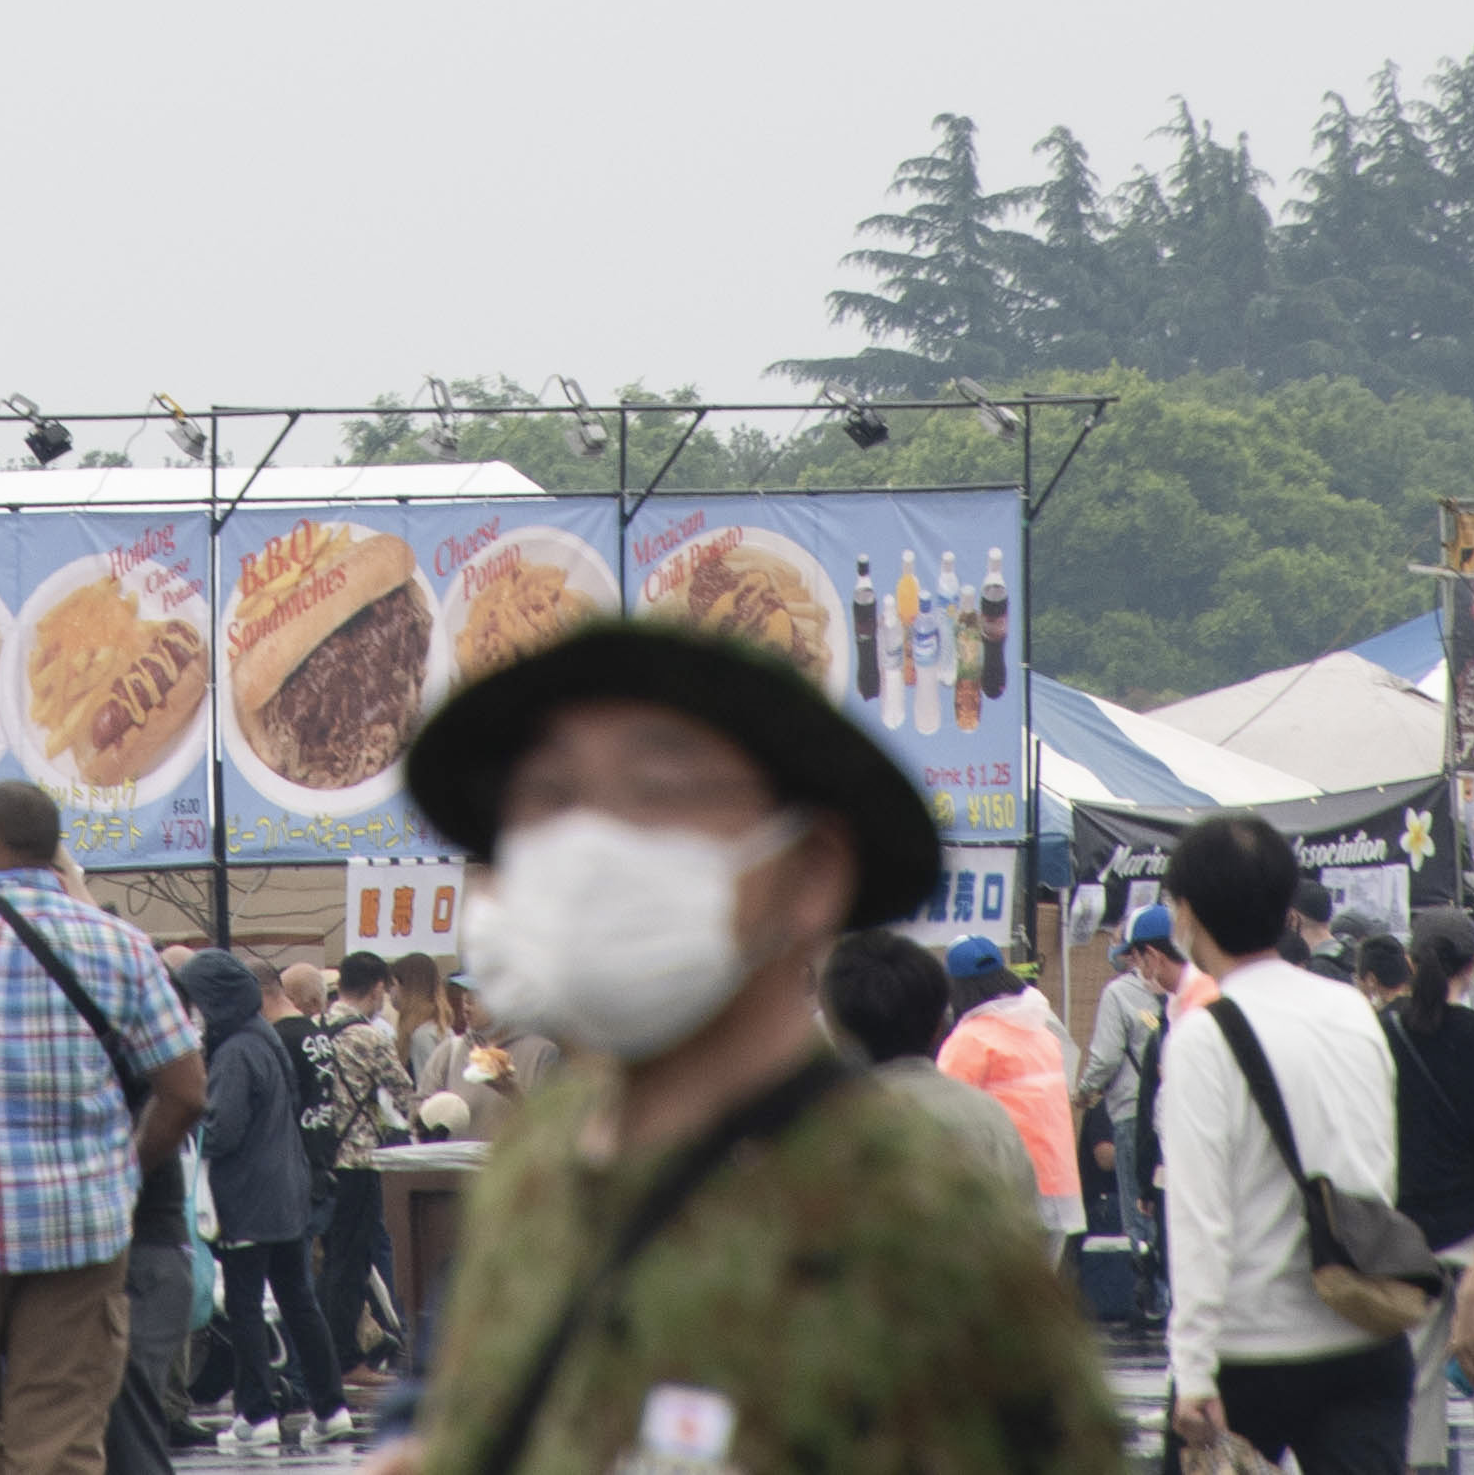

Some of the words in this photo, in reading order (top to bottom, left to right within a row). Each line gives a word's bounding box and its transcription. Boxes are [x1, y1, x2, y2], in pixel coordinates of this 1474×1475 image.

[108, 523, 175, 587] Hotdog
[434, 515, 501, 577] Cheese
[633, 509, 705, 564] Mexican
[462, 543, 521, 602] Potato
[227, 561, 347, 661] Sandwiches
[925, 765, 962, 786] Drink
[162, 818, 208, 851] ¥750
[967, 792, 1016, 830] ¥150
[925, 868, 1006, 923] 販売口
